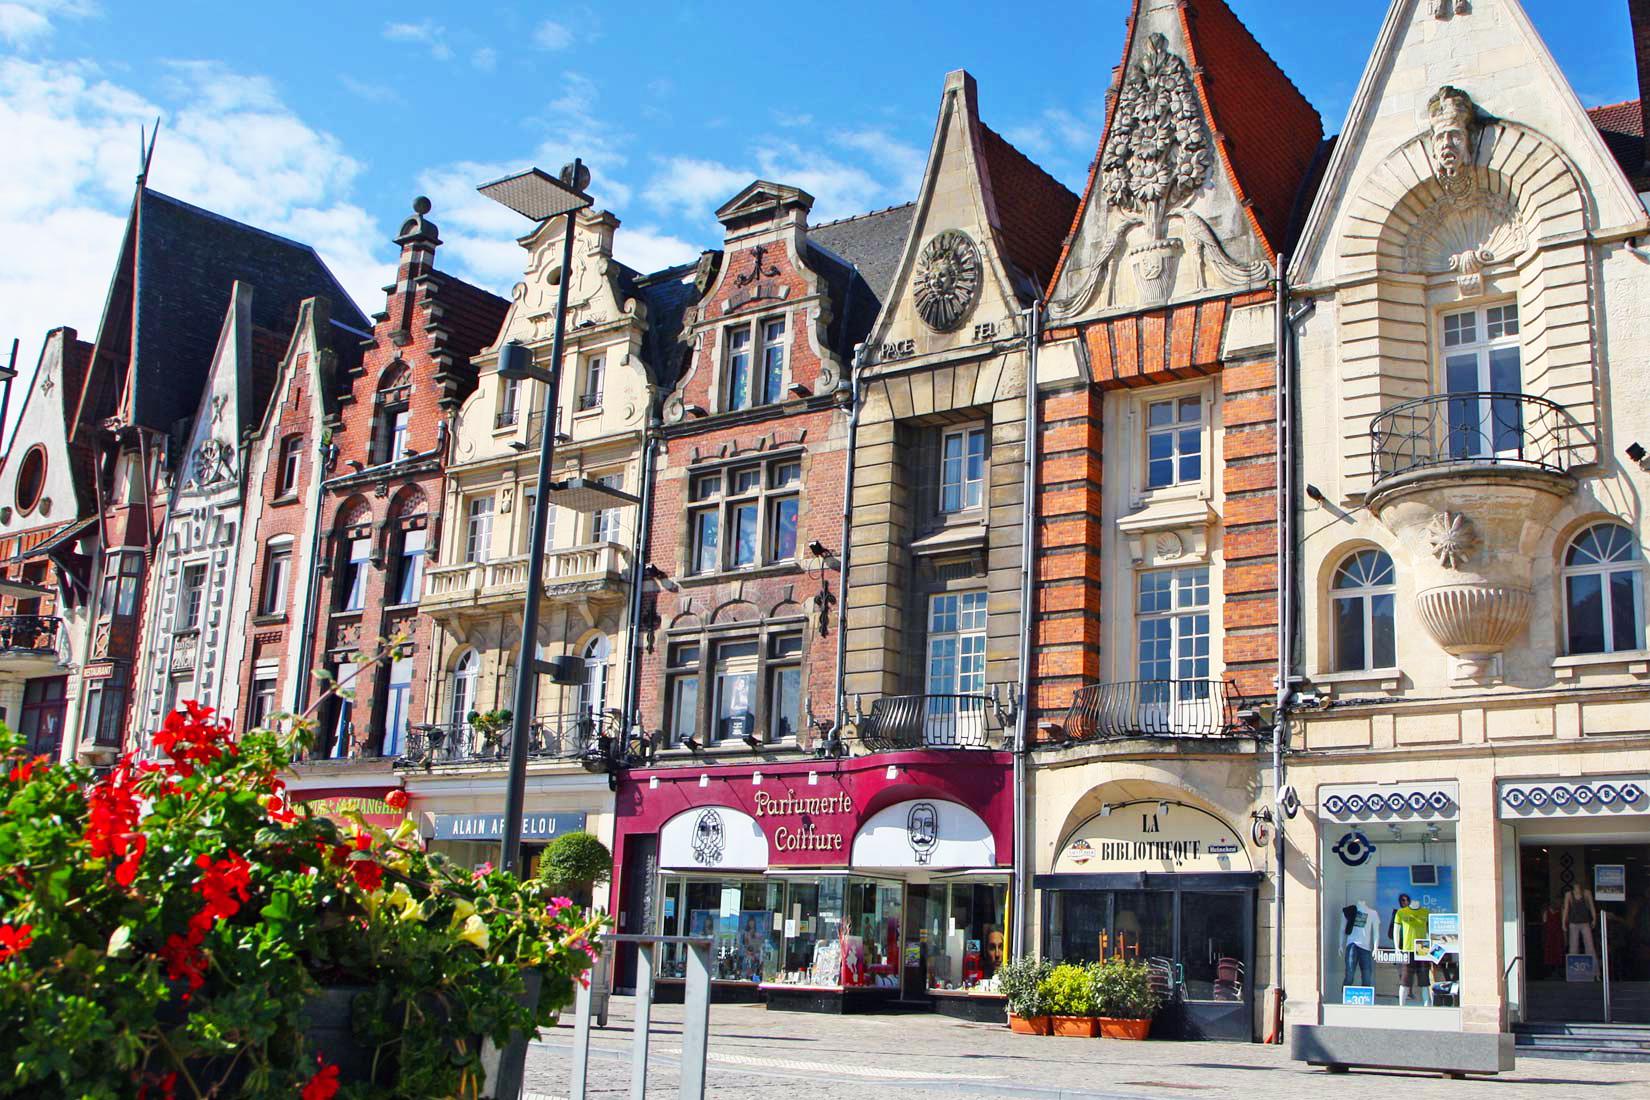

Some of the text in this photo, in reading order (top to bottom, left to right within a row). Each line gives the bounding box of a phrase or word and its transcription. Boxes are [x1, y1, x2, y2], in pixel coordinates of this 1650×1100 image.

[881, 339, 915, 358] PACE
[754, 788, 852, 816] Parfumerie
[452, 818, 556, 834] ALAIN AFELOU
[1142, 814, 1160, 833] LA
[775, 824, 842, 851] Coiffure
